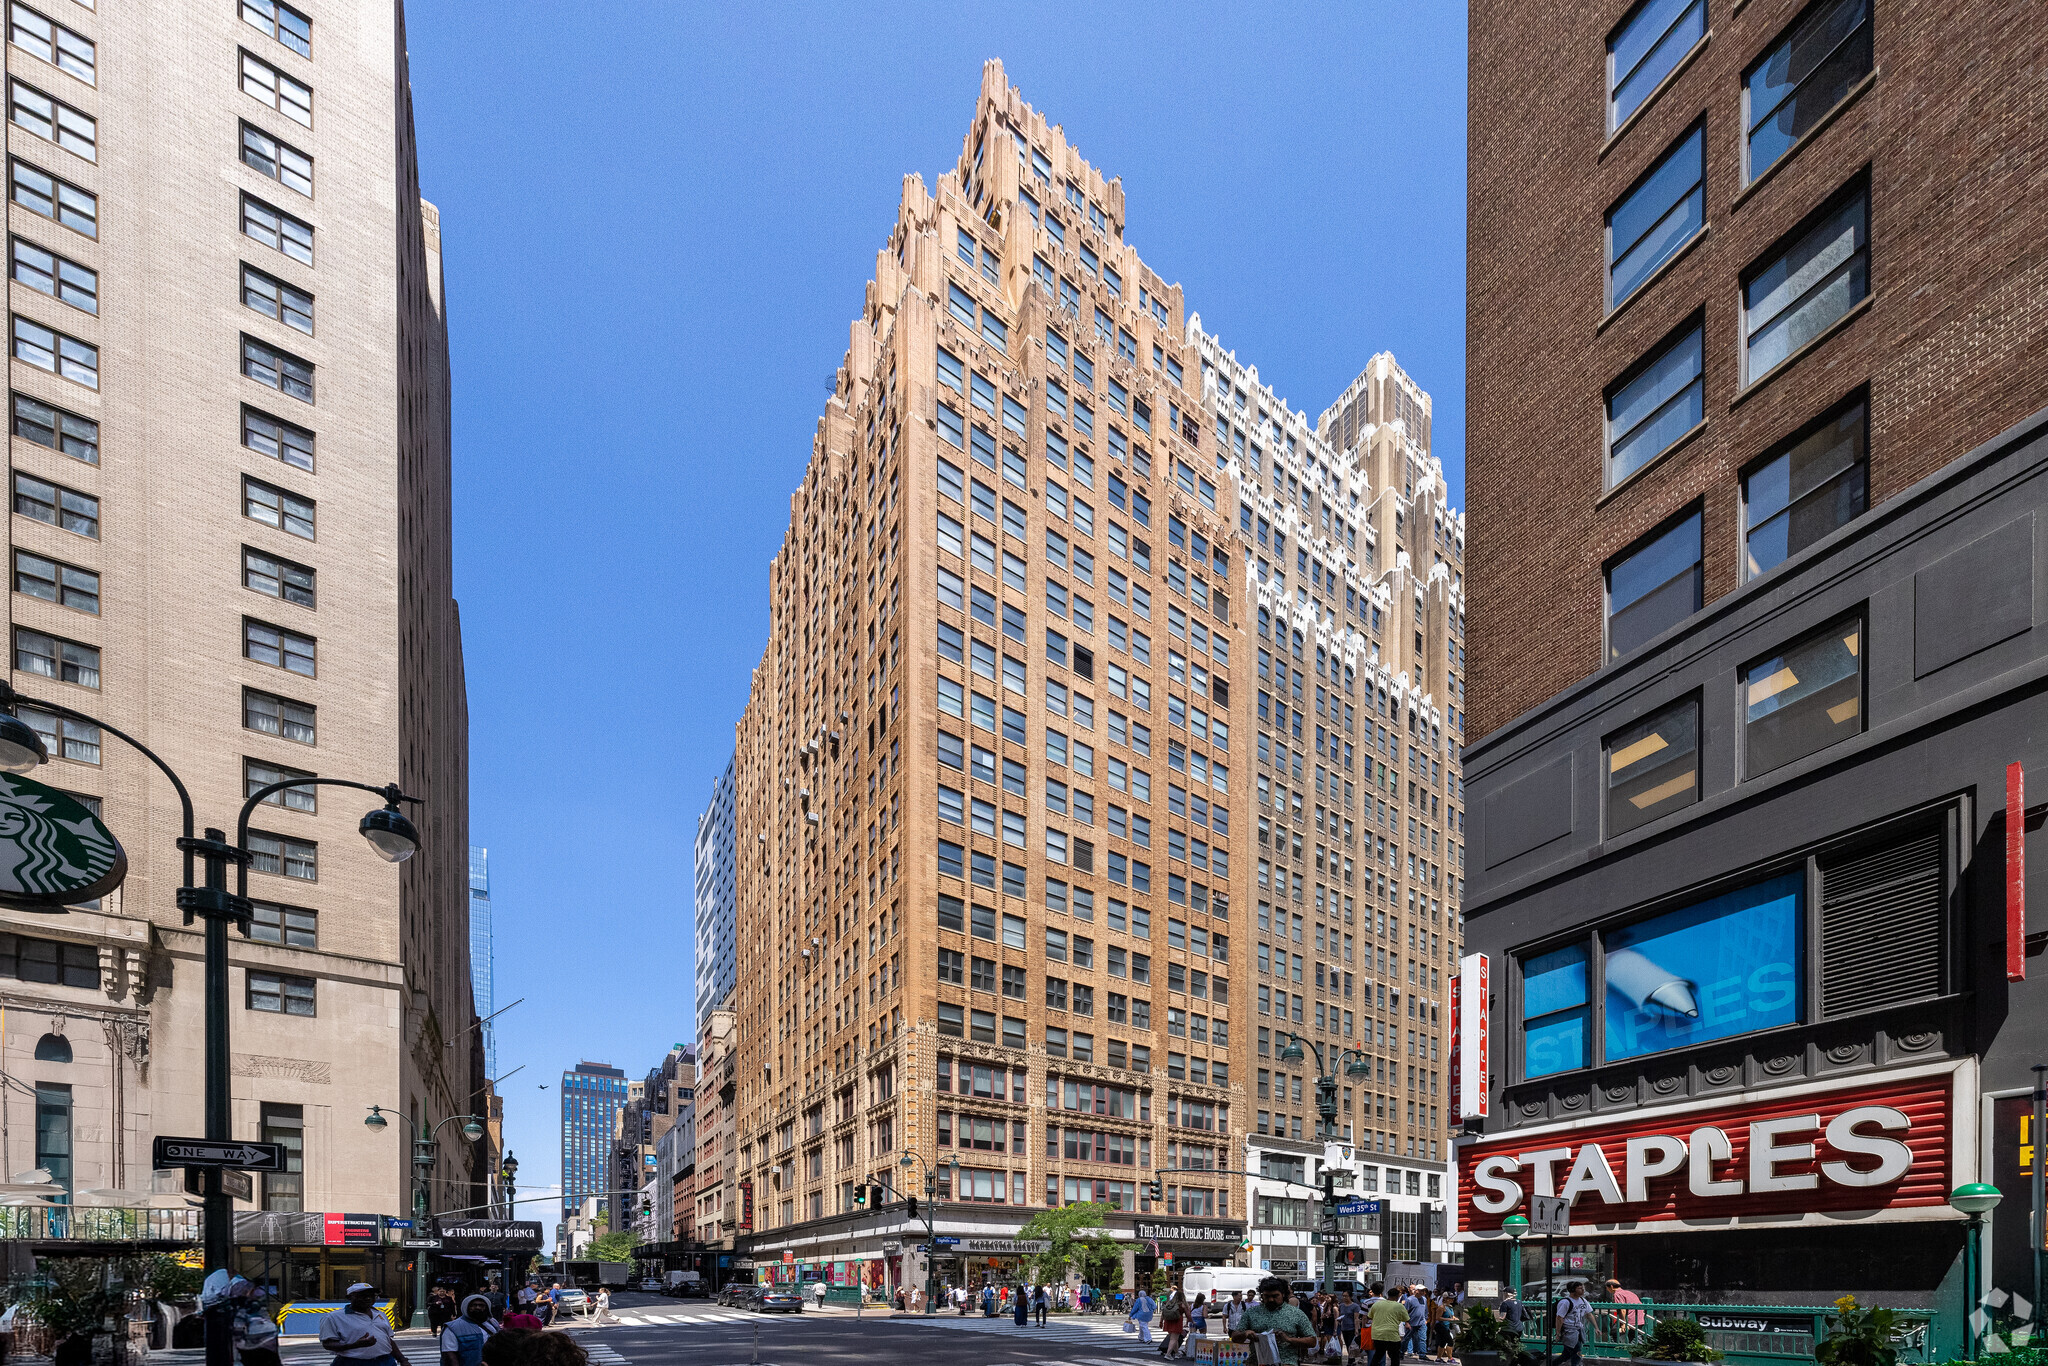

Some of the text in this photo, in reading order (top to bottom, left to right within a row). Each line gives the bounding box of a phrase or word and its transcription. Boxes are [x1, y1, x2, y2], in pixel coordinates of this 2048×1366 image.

[1479, 966, 1487, 1105] STAPLES
[1452, 985, 1461, 1116] STAPLES
[168, 1146, 258, 1160] ONE WAY
[1472, 1105, 1914, 1214] STAPLES
[1356, 1204, 1369, 1212] 35th
[456, 1228, 535, 1238] TRATTORIA BIANCA
[1139, 1224, 1224, 1240] THE TAILOR PUBLIC HOUSE
[1533, 1222, 1549, 1230] ONLY
[1552, 1223, 1567, 1232] ONLY
[1393, 1277, 1425, 1286] EKKO
[1699, 1316, 1768, 1332] Subway
